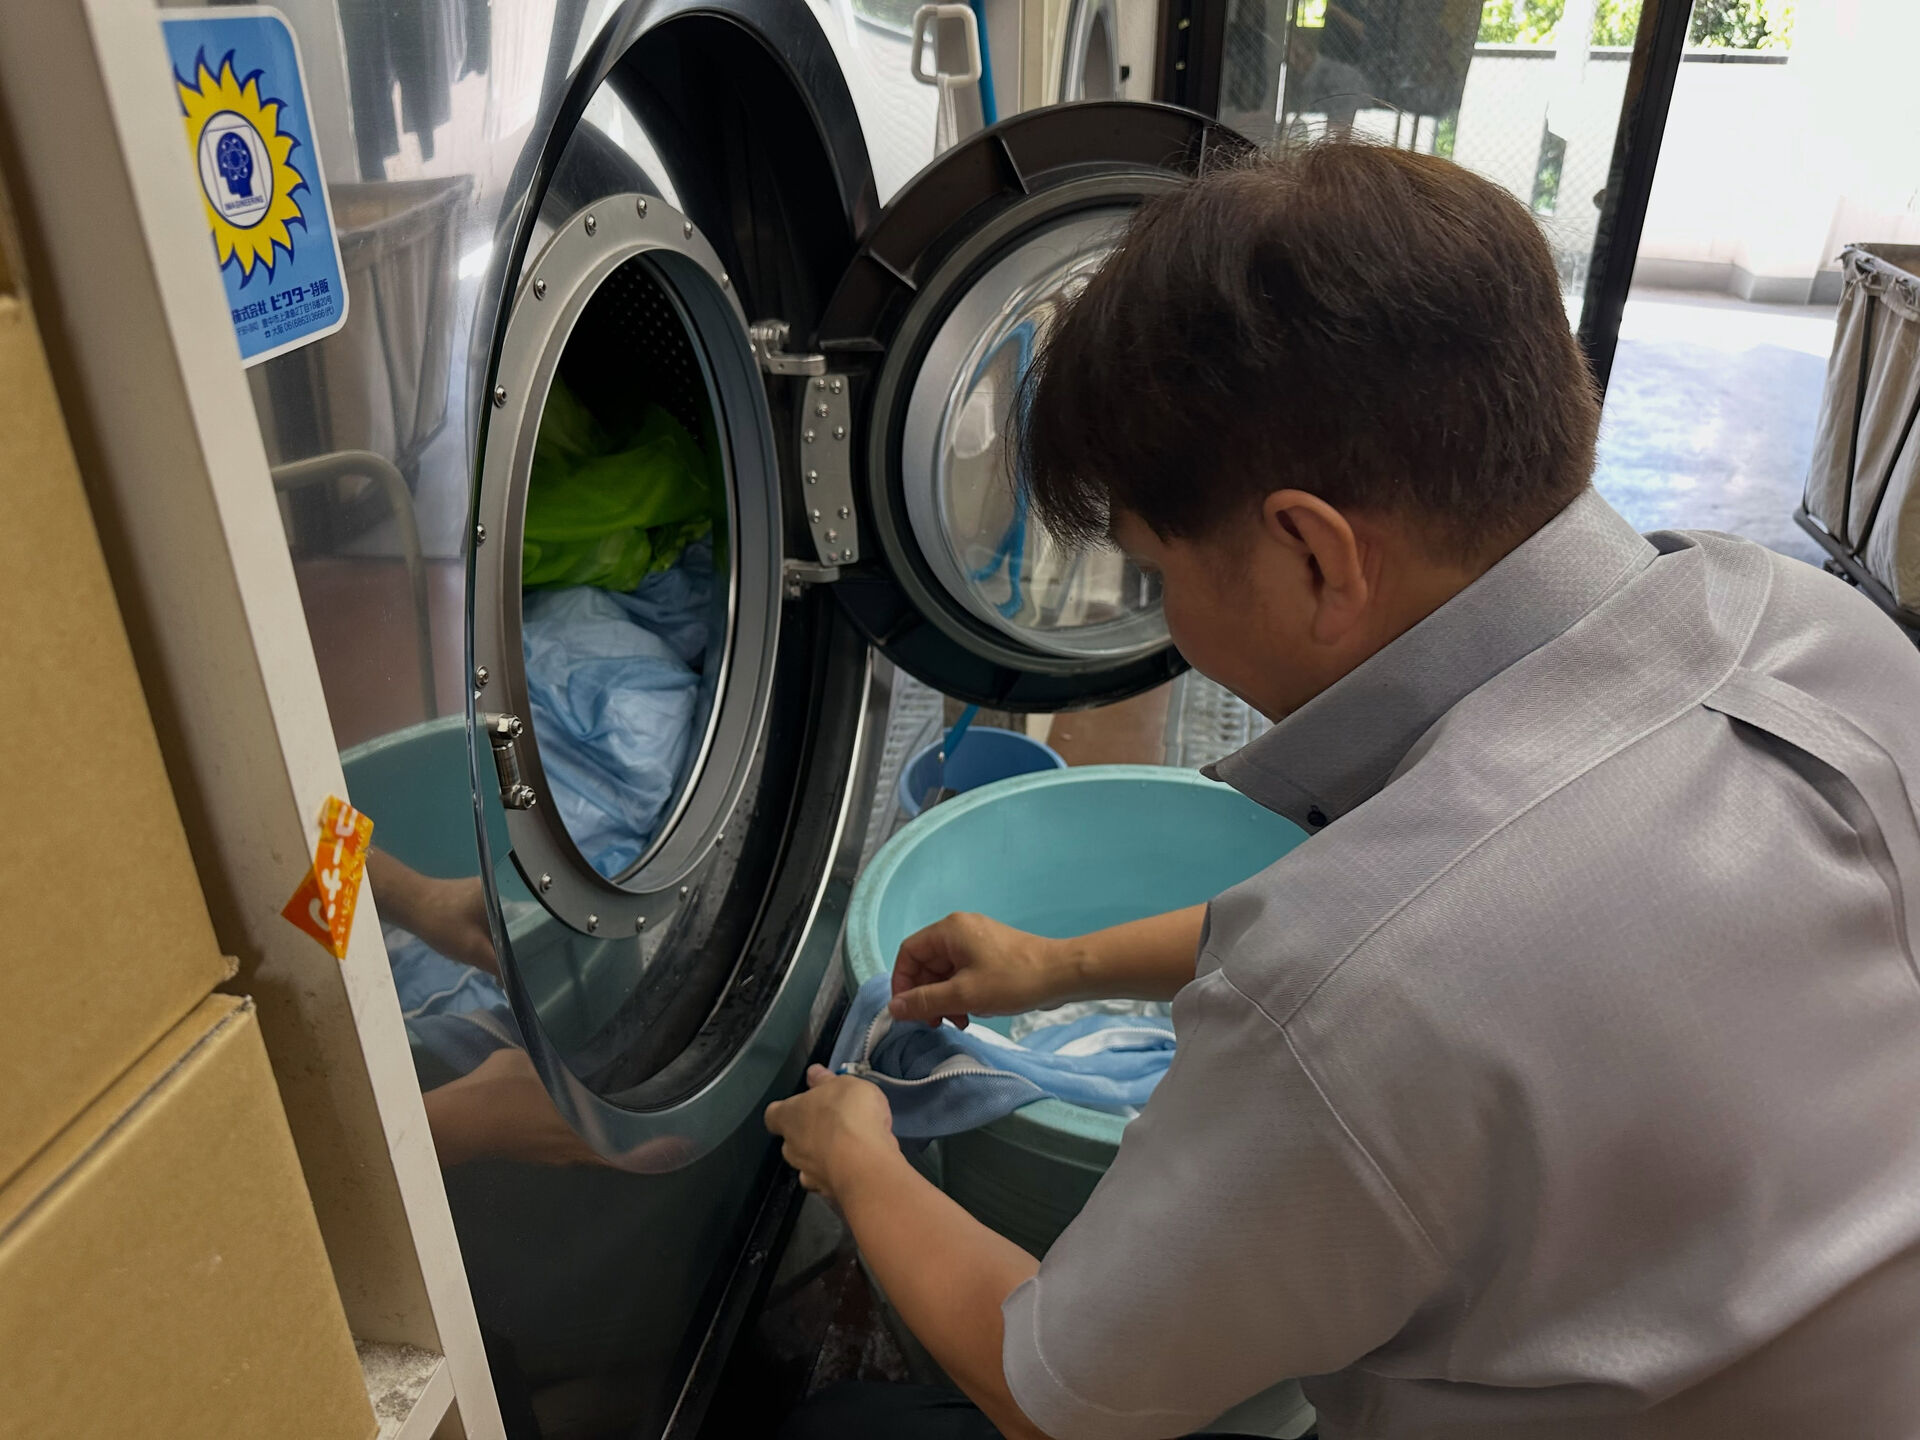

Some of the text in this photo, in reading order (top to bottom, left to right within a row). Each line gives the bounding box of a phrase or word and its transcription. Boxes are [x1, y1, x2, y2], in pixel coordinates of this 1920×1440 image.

[270, 278, 330, 311] ビクター特販
